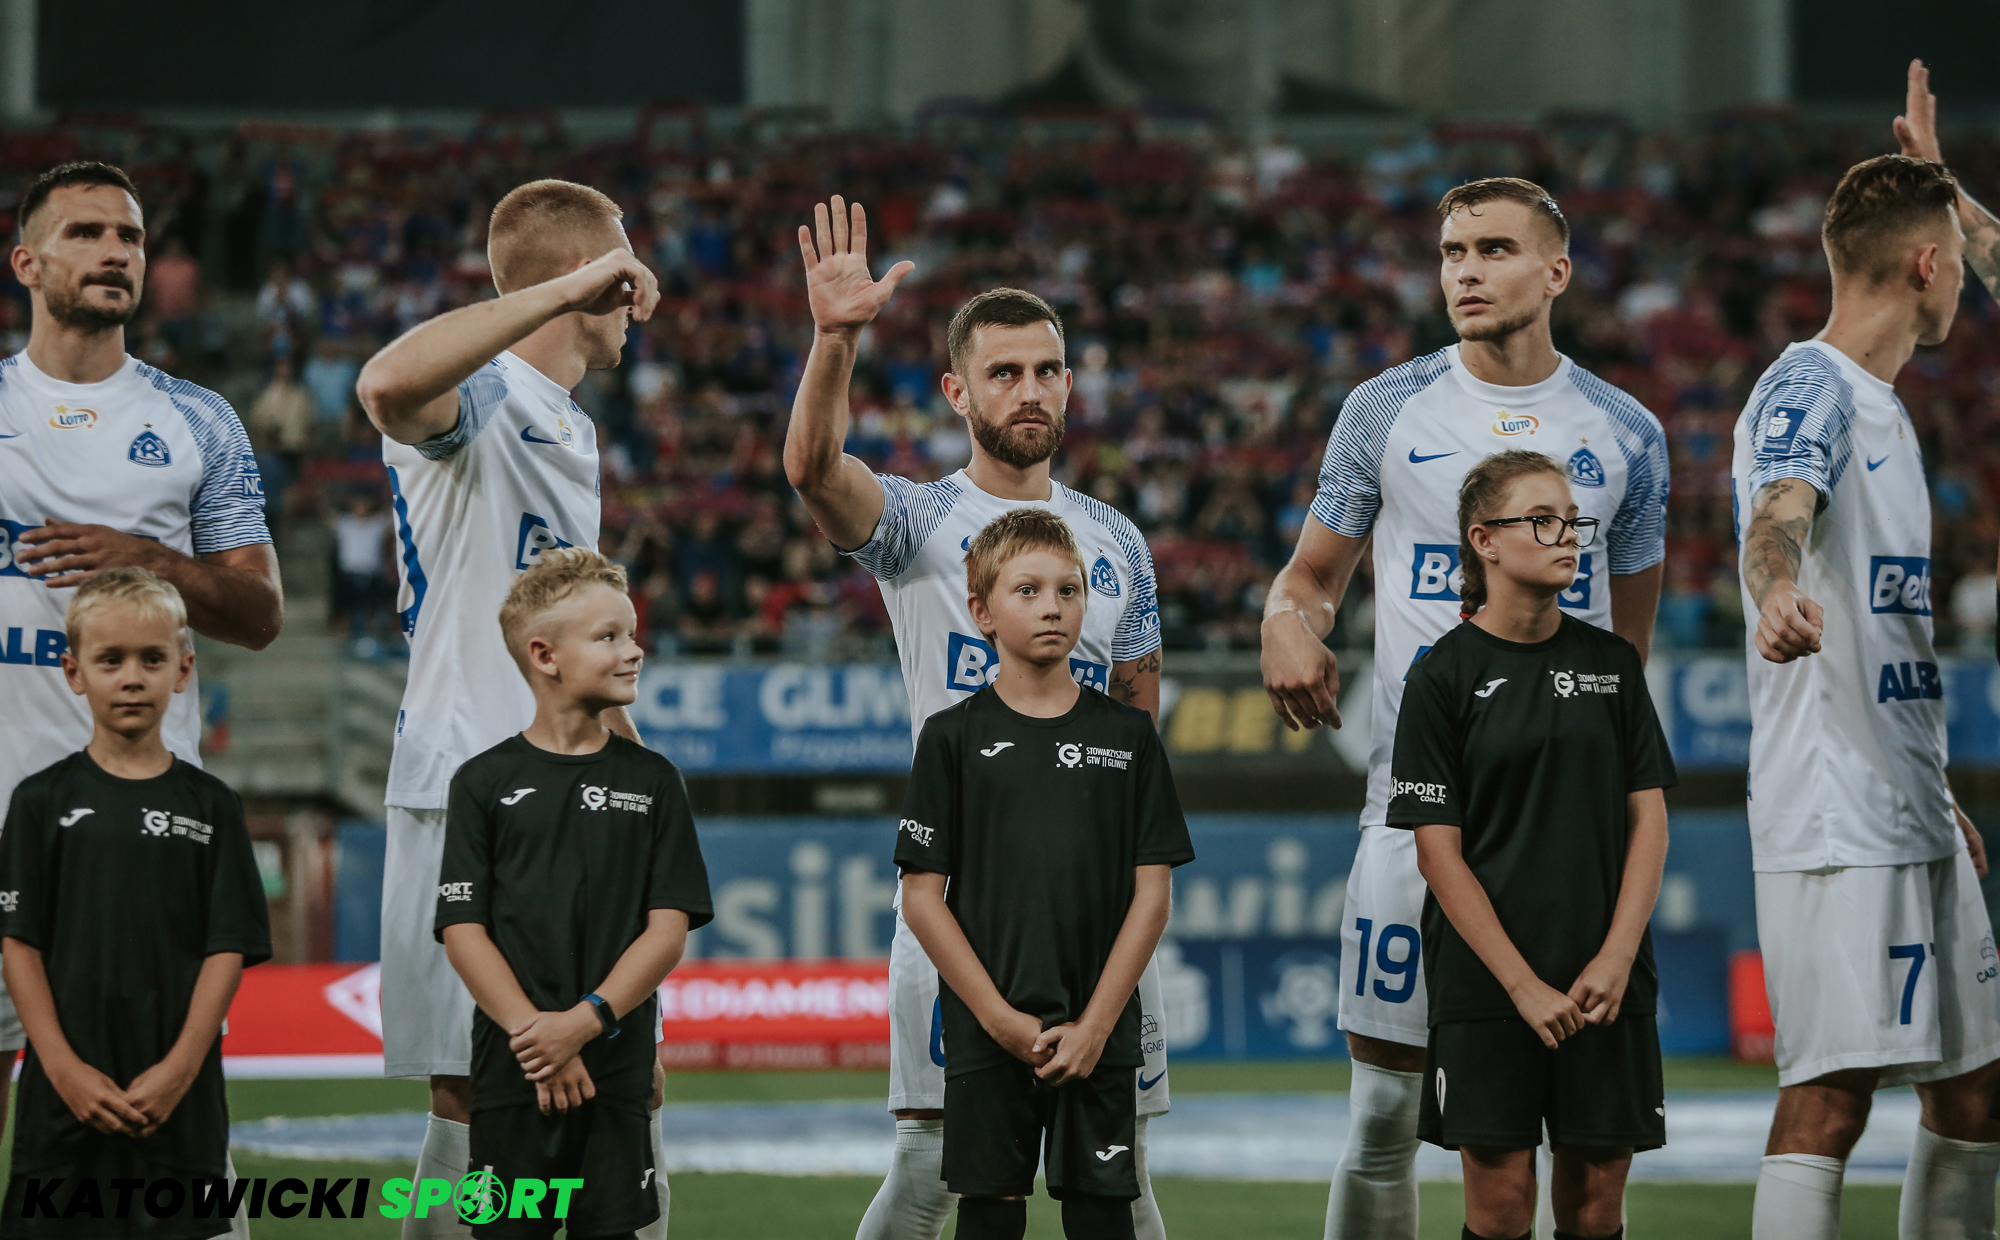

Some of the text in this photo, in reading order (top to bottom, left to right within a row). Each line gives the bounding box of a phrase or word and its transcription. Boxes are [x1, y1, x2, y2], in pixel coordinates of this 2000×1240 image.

[59, 414, 89, 425] LOTTO
[1501, 420, 1530, 431] LOTTO
[1086, 756, 1101, 765] GTW
[1355, 917, 1421, 1004] 19
[1888, 942, 1936, 1025] 7
